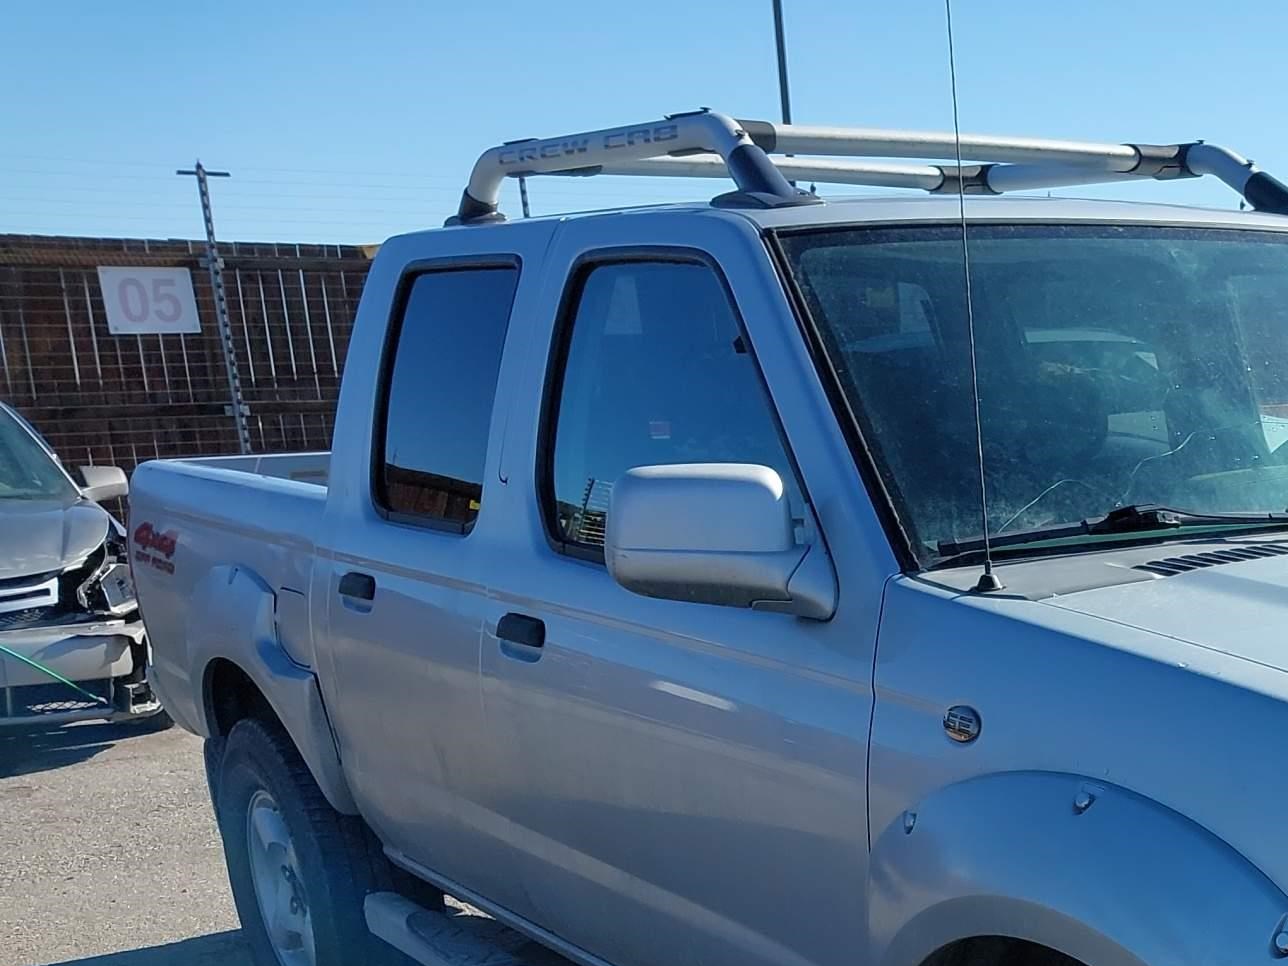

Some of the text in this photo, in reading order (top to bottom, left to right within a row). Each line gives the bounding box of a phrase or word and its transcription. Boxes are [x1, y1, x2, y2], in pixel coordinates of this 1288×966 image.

[499, 124, 679, 165] CREW CAB
[118, 278, 183, 323] 05
